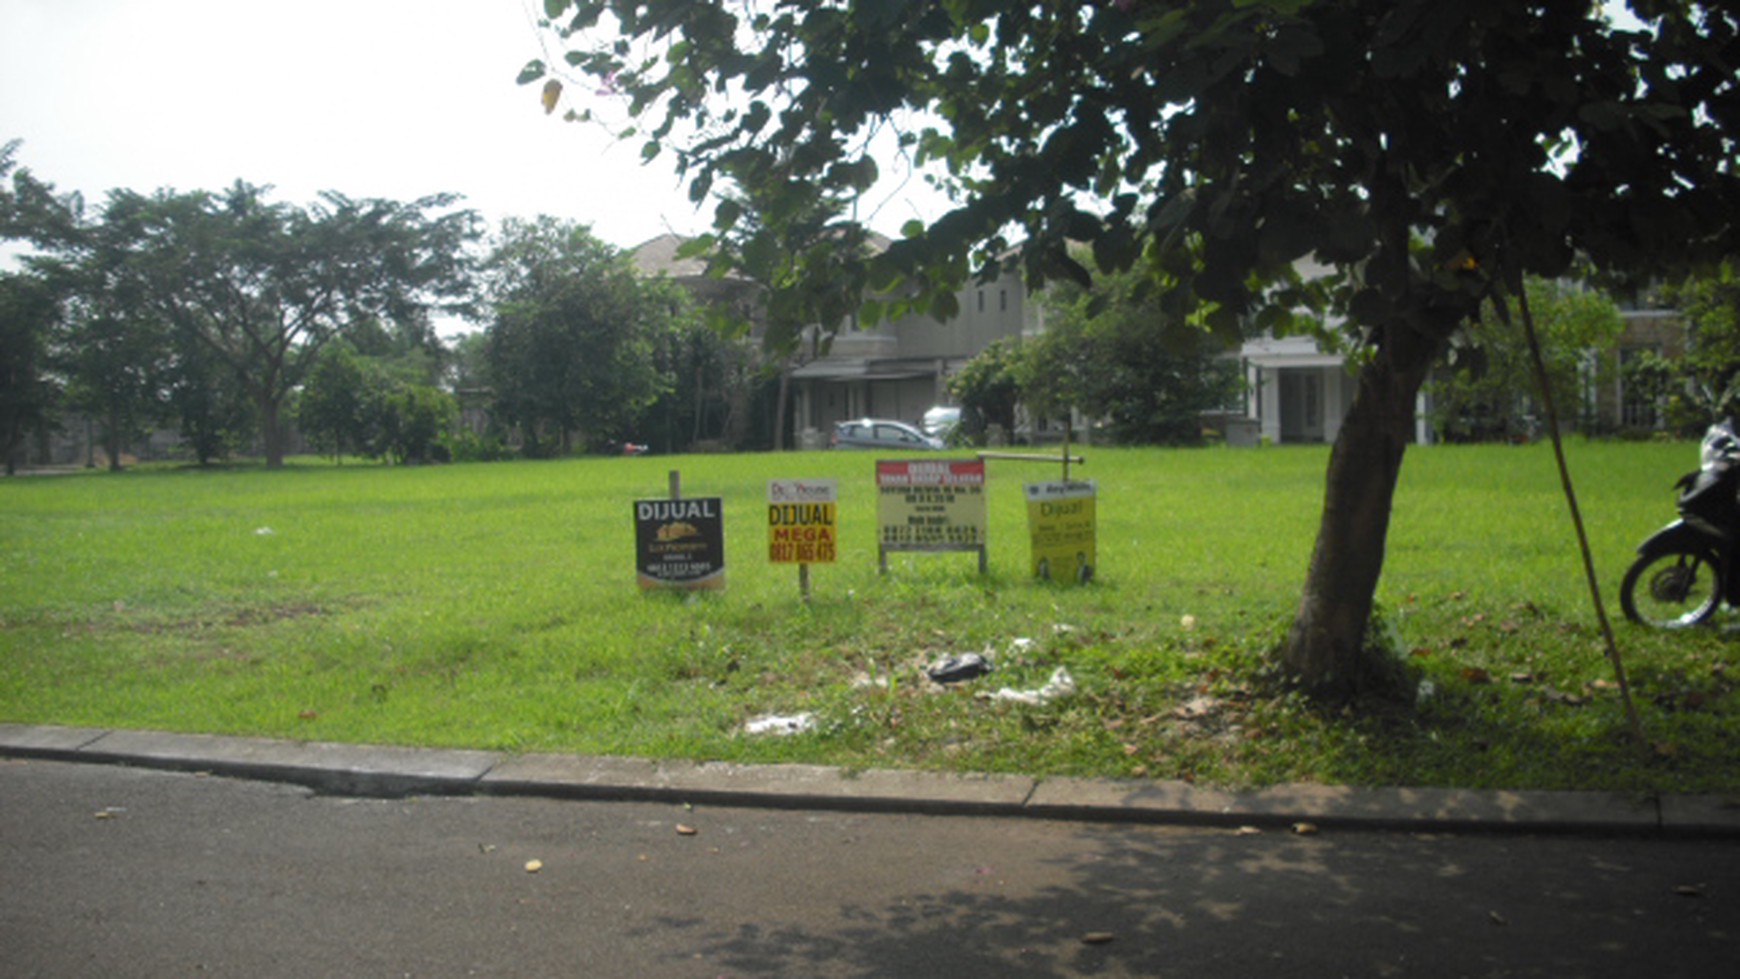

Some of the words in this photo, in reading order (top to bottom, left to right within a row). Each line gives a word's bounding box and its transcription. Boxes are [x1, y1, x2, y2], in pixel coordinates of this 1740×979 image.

[638, 500, 716, 520] DIJUAL
[769, 504, 832, 526] DIJUAL
[775, 528, 832, 542] MEGA
